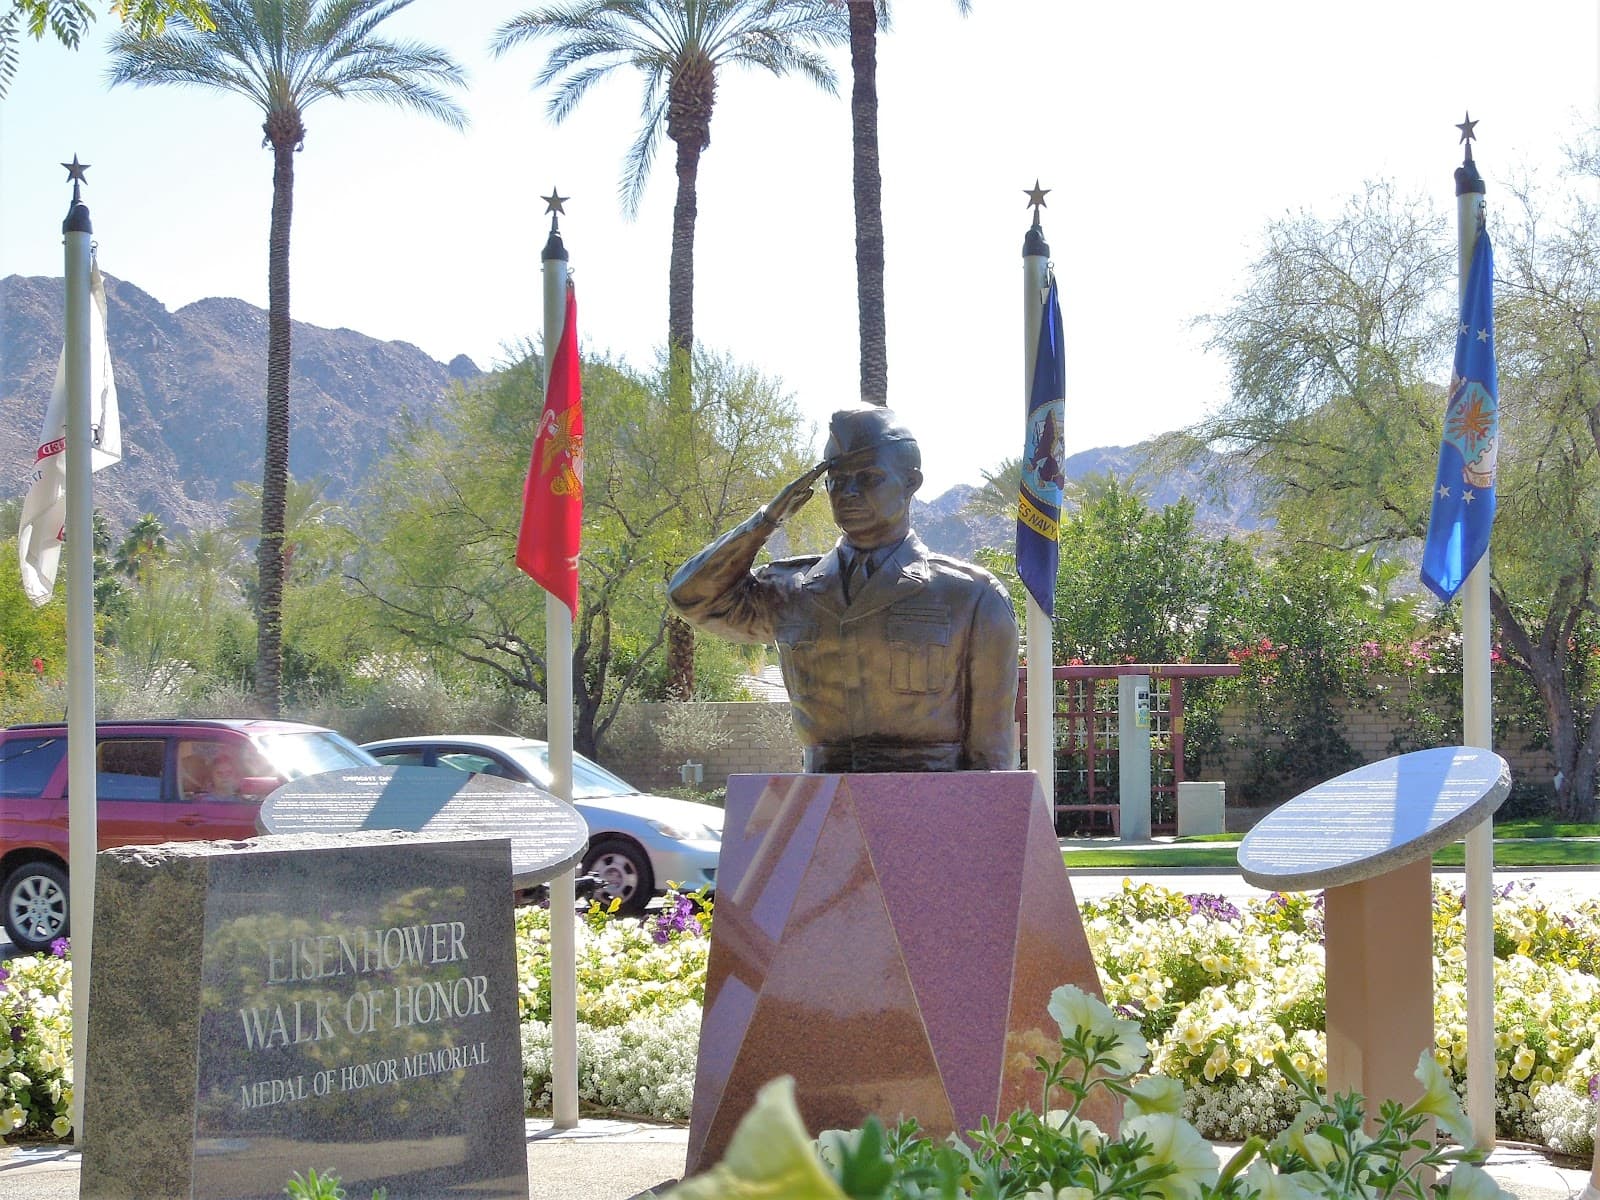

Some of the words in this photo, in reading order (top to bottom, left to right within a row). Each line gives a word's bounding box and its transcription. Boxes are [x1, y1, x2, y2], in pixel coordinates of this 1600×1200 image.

[1029, 513, 1057, 535] NAVY
[267, 921, 468, 985] EISENHOWER
[239, 998, 336, 1051] WALK
[346, 989, 383, 1034] OF
[393, 975, 491, 1028] HONOR
[240, 1075, 308, 1110] MEDAL
[313, 1069, 336, 1096] OF
[341, 1058, 399, 1090] HONOR
[403, 1042, 489, 1079] MEMORIAL
